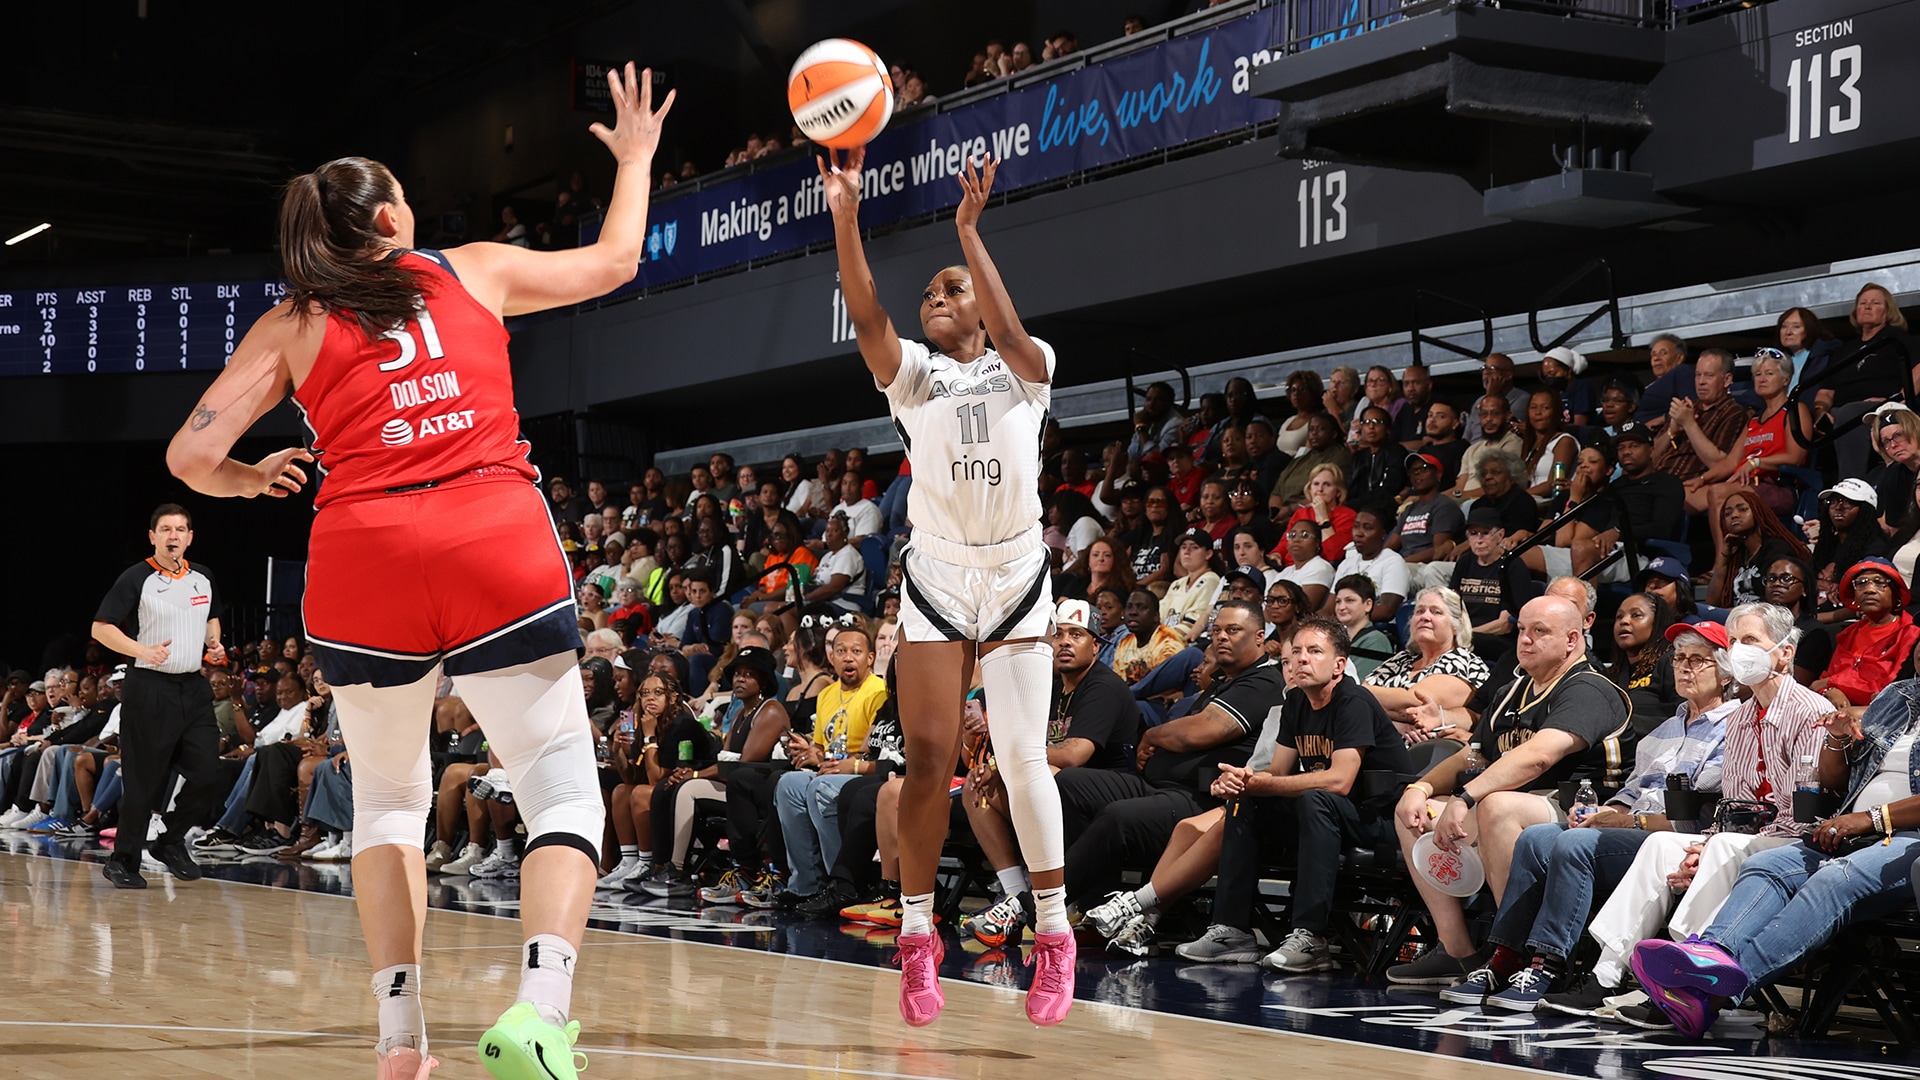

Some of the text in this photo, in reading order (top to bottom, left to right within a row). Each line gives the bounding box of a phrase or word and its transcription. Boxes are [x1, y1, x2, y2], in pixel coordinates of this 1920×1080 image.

[1795, 18, 1853, 47] SECTION
[1787, 44, 1862, 143] 113
[700, 37, 1283, 247] Making a diffence where we live, work an
[1298, 169, 1347, 248] 113
[36, 292, 58, 306] PTS
[76, 290, 106, 304] ASST
[128, 289, 152, 302] REB
[171, 287, 192, 300] STL
[217, 284, 240, 299] BLK
[265, 283, 286, 297] FLS
[40, 308, 57, 320] 13
[89, 306, 98, 318] 3
[137, 304, 146, 316] 3
[180, 303, 188, 315] 0
[228, 300, 235, 313] 1
[44, 321, 52, 333] 2
[89, 319, 97, 332] 3
[137, 318, 145, 330] 0
[179, 316, 188, 328] 0
[226, 314, 235, 327] 0
[832, 288, 857, 343] 11
[39, 327, 234, 347] 10 2 1 1 0
[377, 293, 445, 372] 31
[42, 361, 51, 373] 2
[88, 360, 96, 372] 0
[136, 358, 145, 371] 0
[180, 357, 187, 369] 1
[44, 341, 234, 360] 1 0 3 1 0
[389, 370, 461, 411] DOLSON
[927, 374, 1011, 401] ACES
[418, 409, 476, 439] AT&T
[956, 402, 990, 445] 11
[951, 454, 1002, 487] ring
